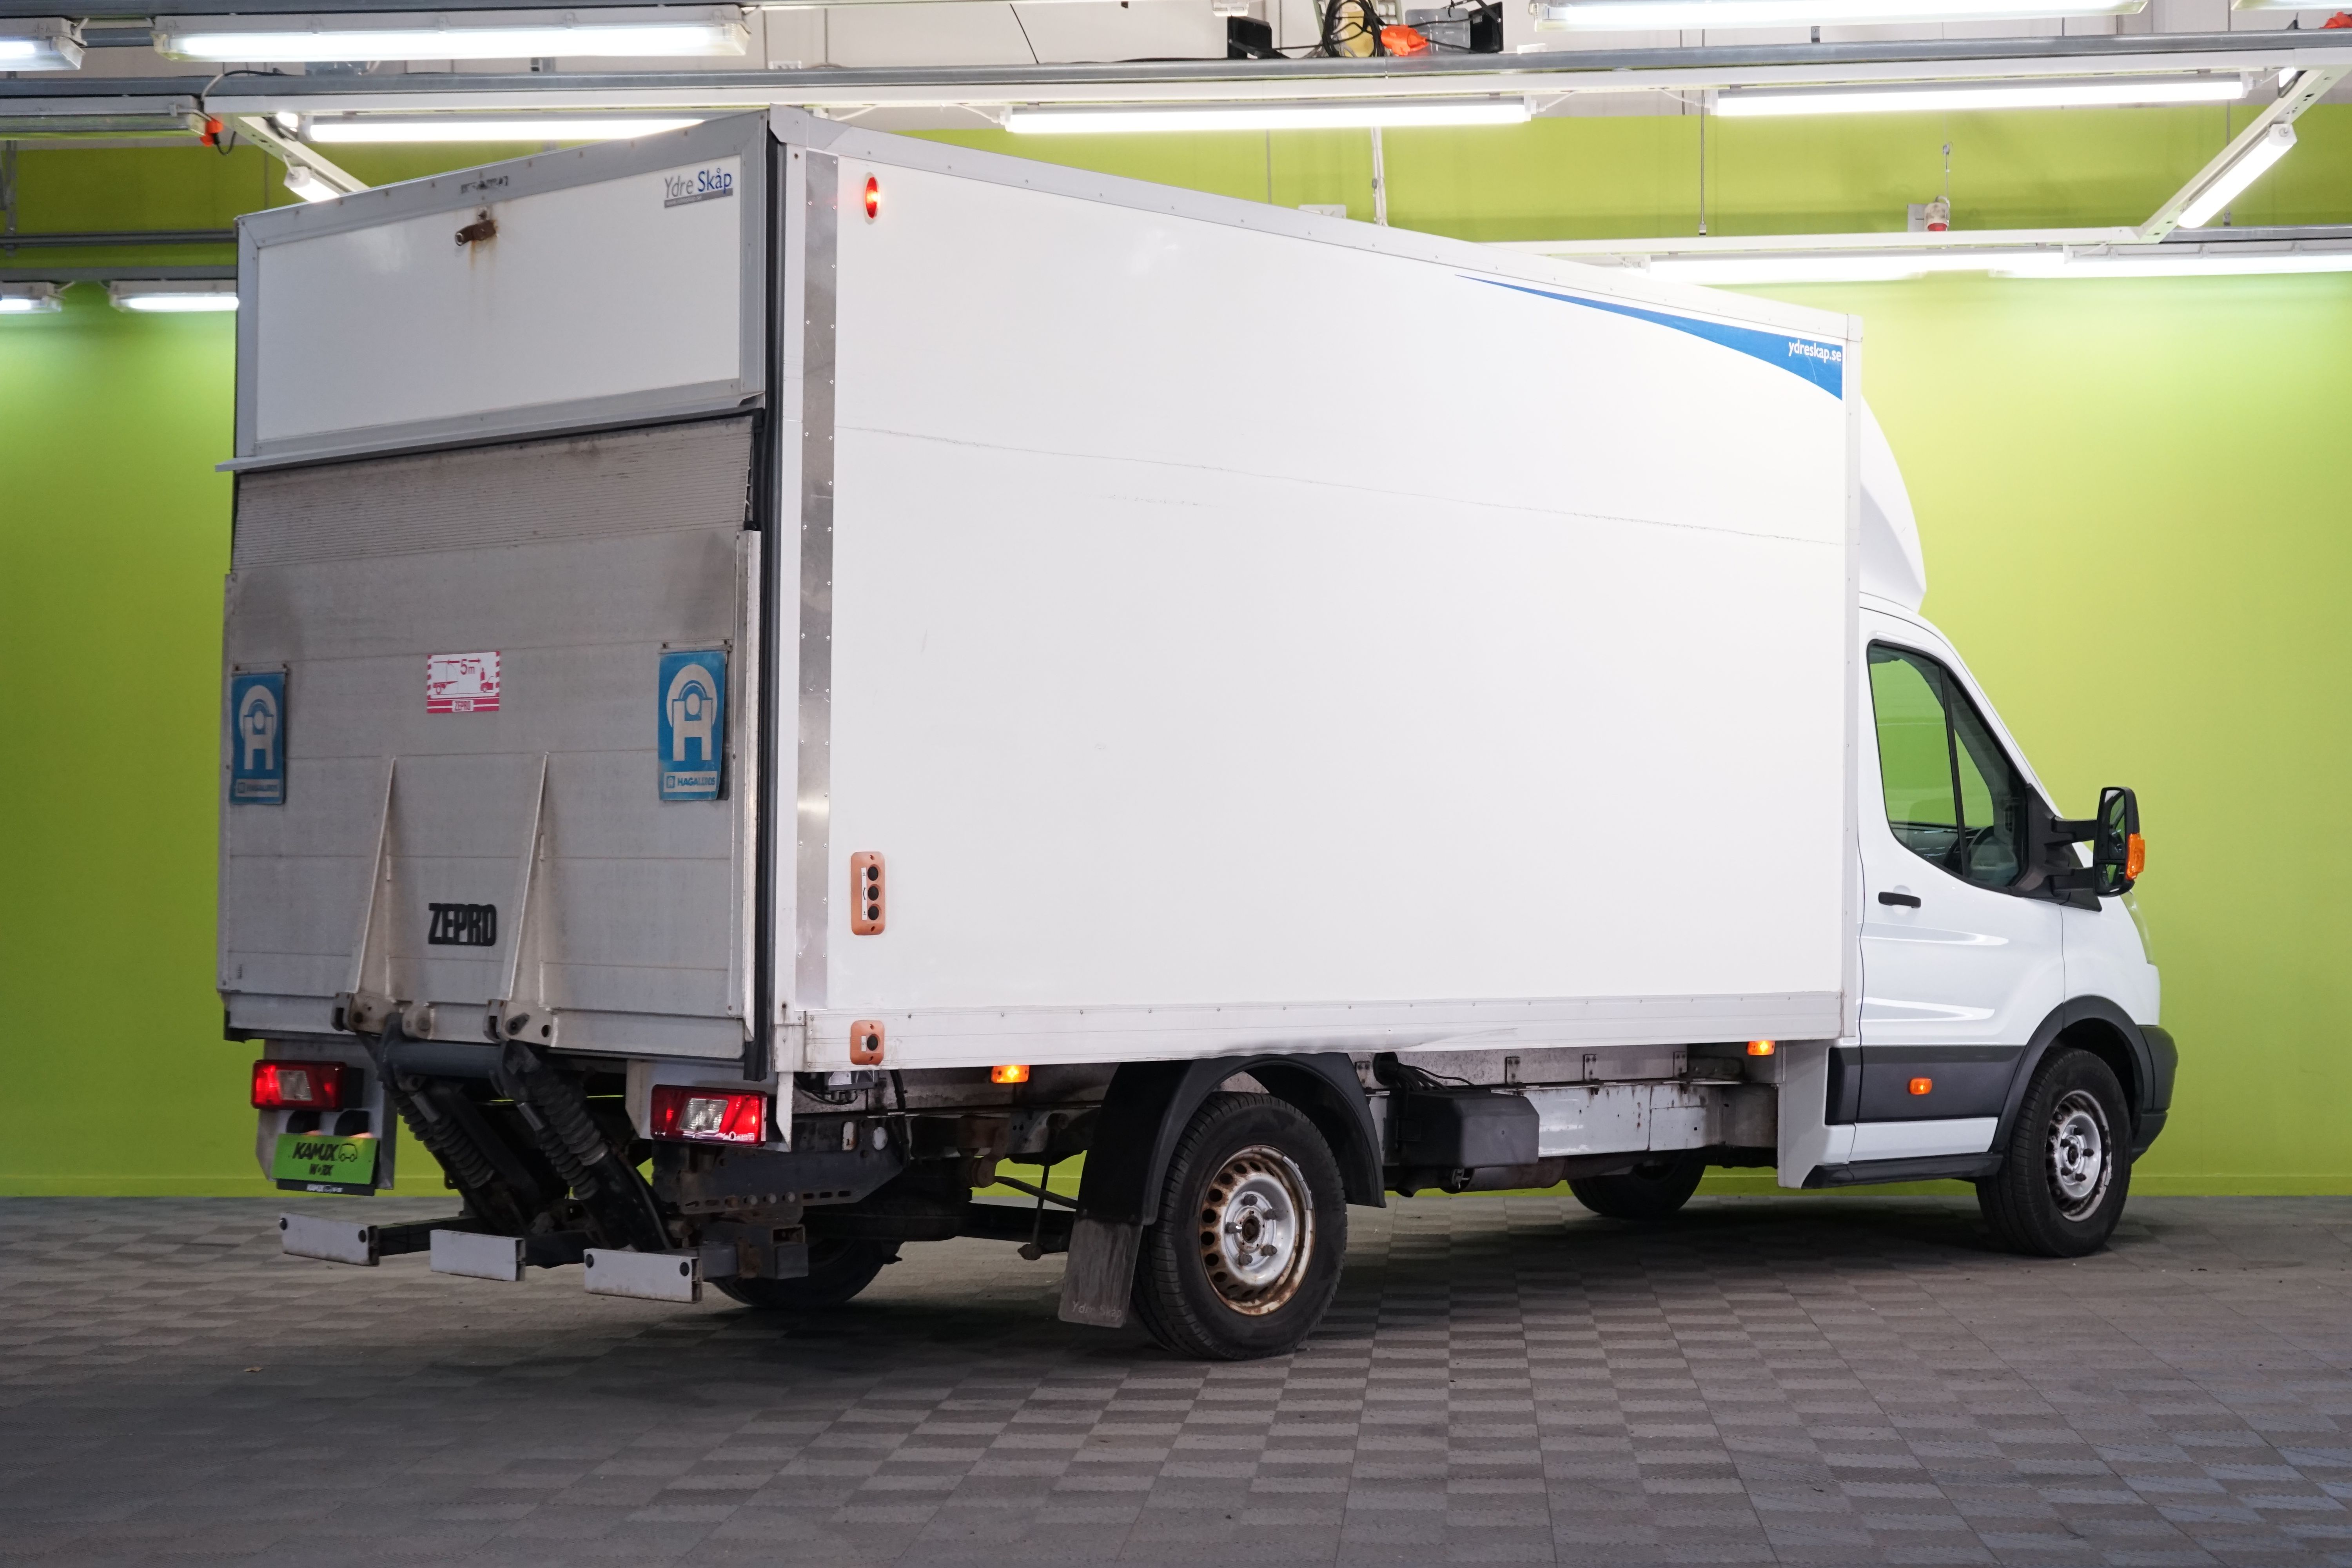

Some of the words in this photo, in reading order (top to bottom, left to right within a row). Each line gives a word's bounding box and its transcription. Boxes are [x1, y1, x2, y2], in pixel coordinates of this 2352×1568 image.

[664, 176, 693, 198] Ydre
[697, 167, 732, 194] Skåp
[1788, 339, 1842, 363] ydreskap.se
[428, 903, 497, 947] ZEPRO
[292, 1142, 339, 1161] KAMUX
